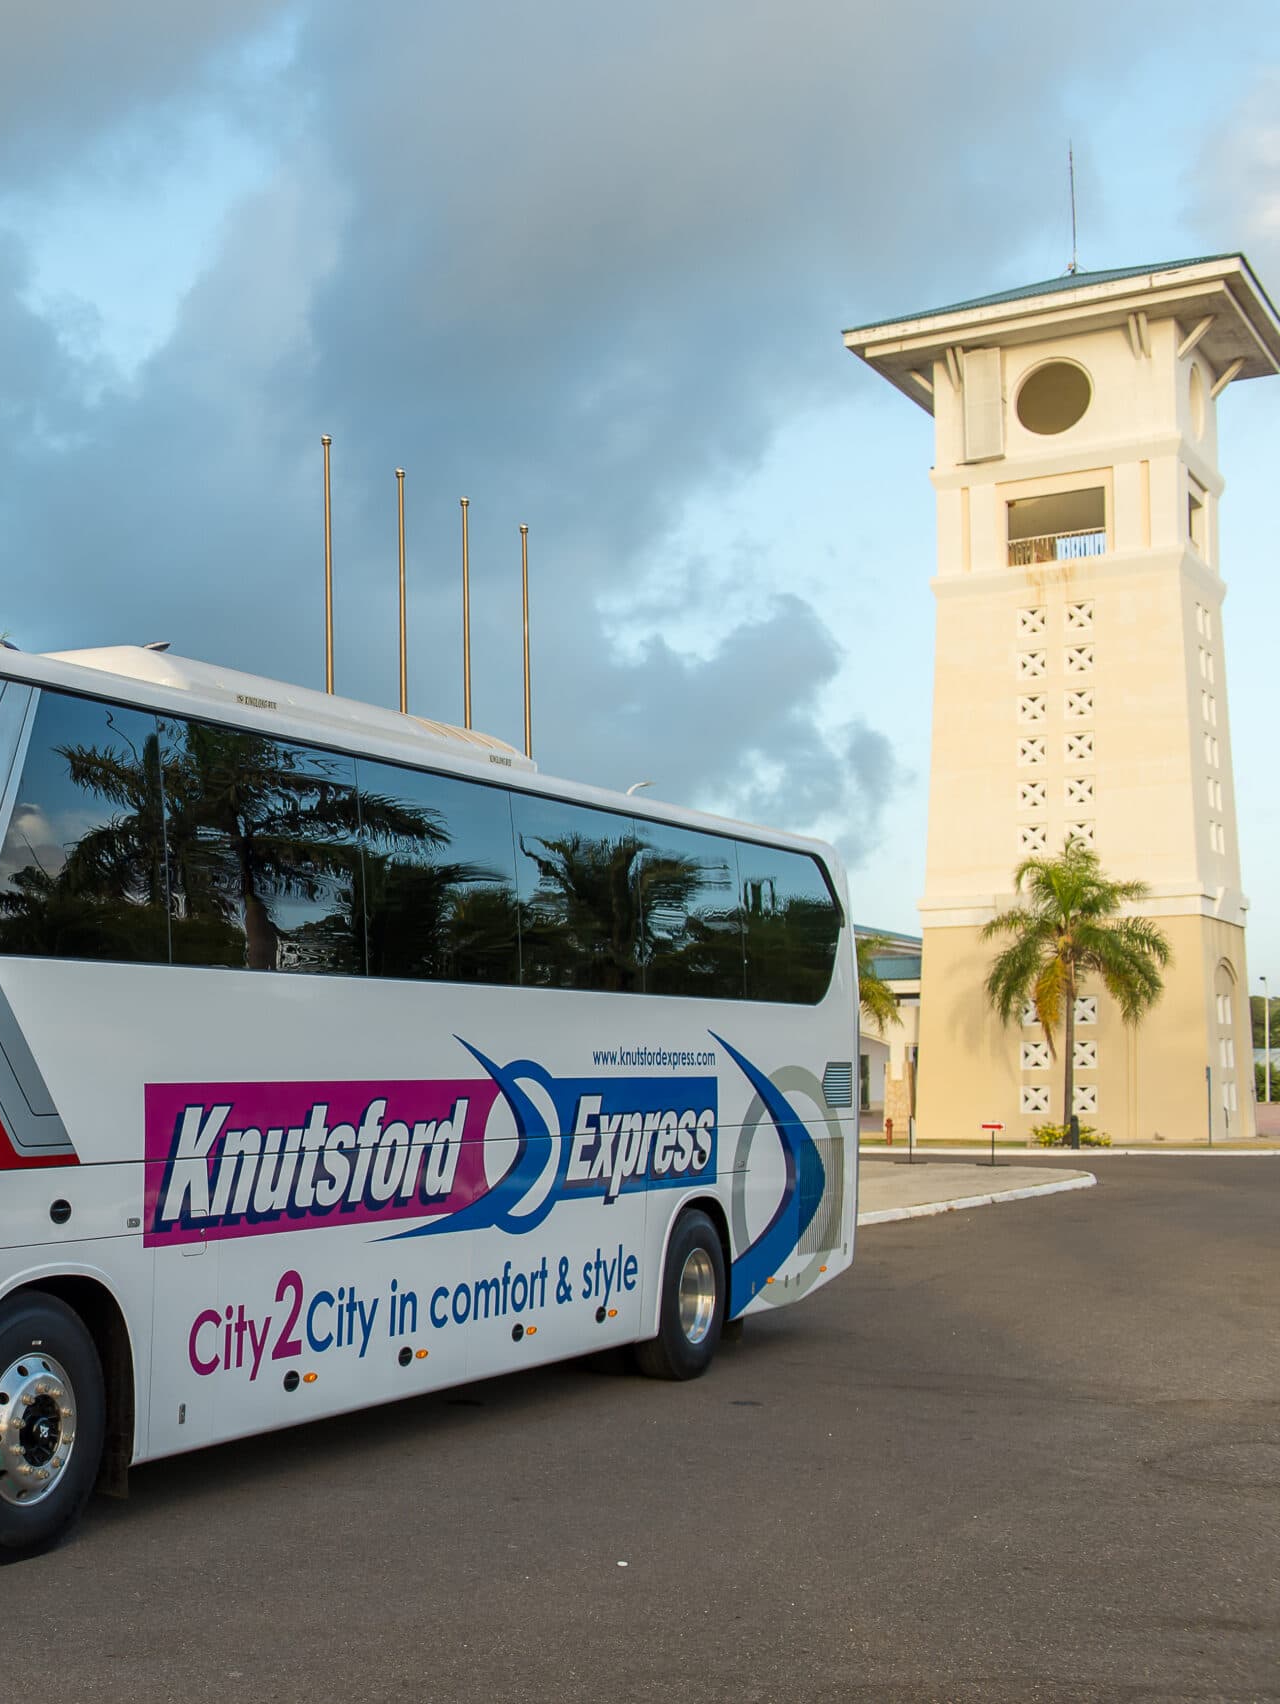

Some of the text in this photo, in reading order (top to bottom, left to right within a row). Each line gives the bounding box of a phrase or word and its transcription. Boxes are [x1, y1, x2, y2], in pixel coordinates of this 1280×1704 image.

[592, 1047, 716, 1070] www.knutsfordexpress.com
[157, 1094, 715, 1226] Knutsford Express
[389, 1278, 418, 1337] in
[429, 1255, 548, 1328] comfort
[556, 1255, 573, 1305] &
[581, 1244, 639, 1307] style
